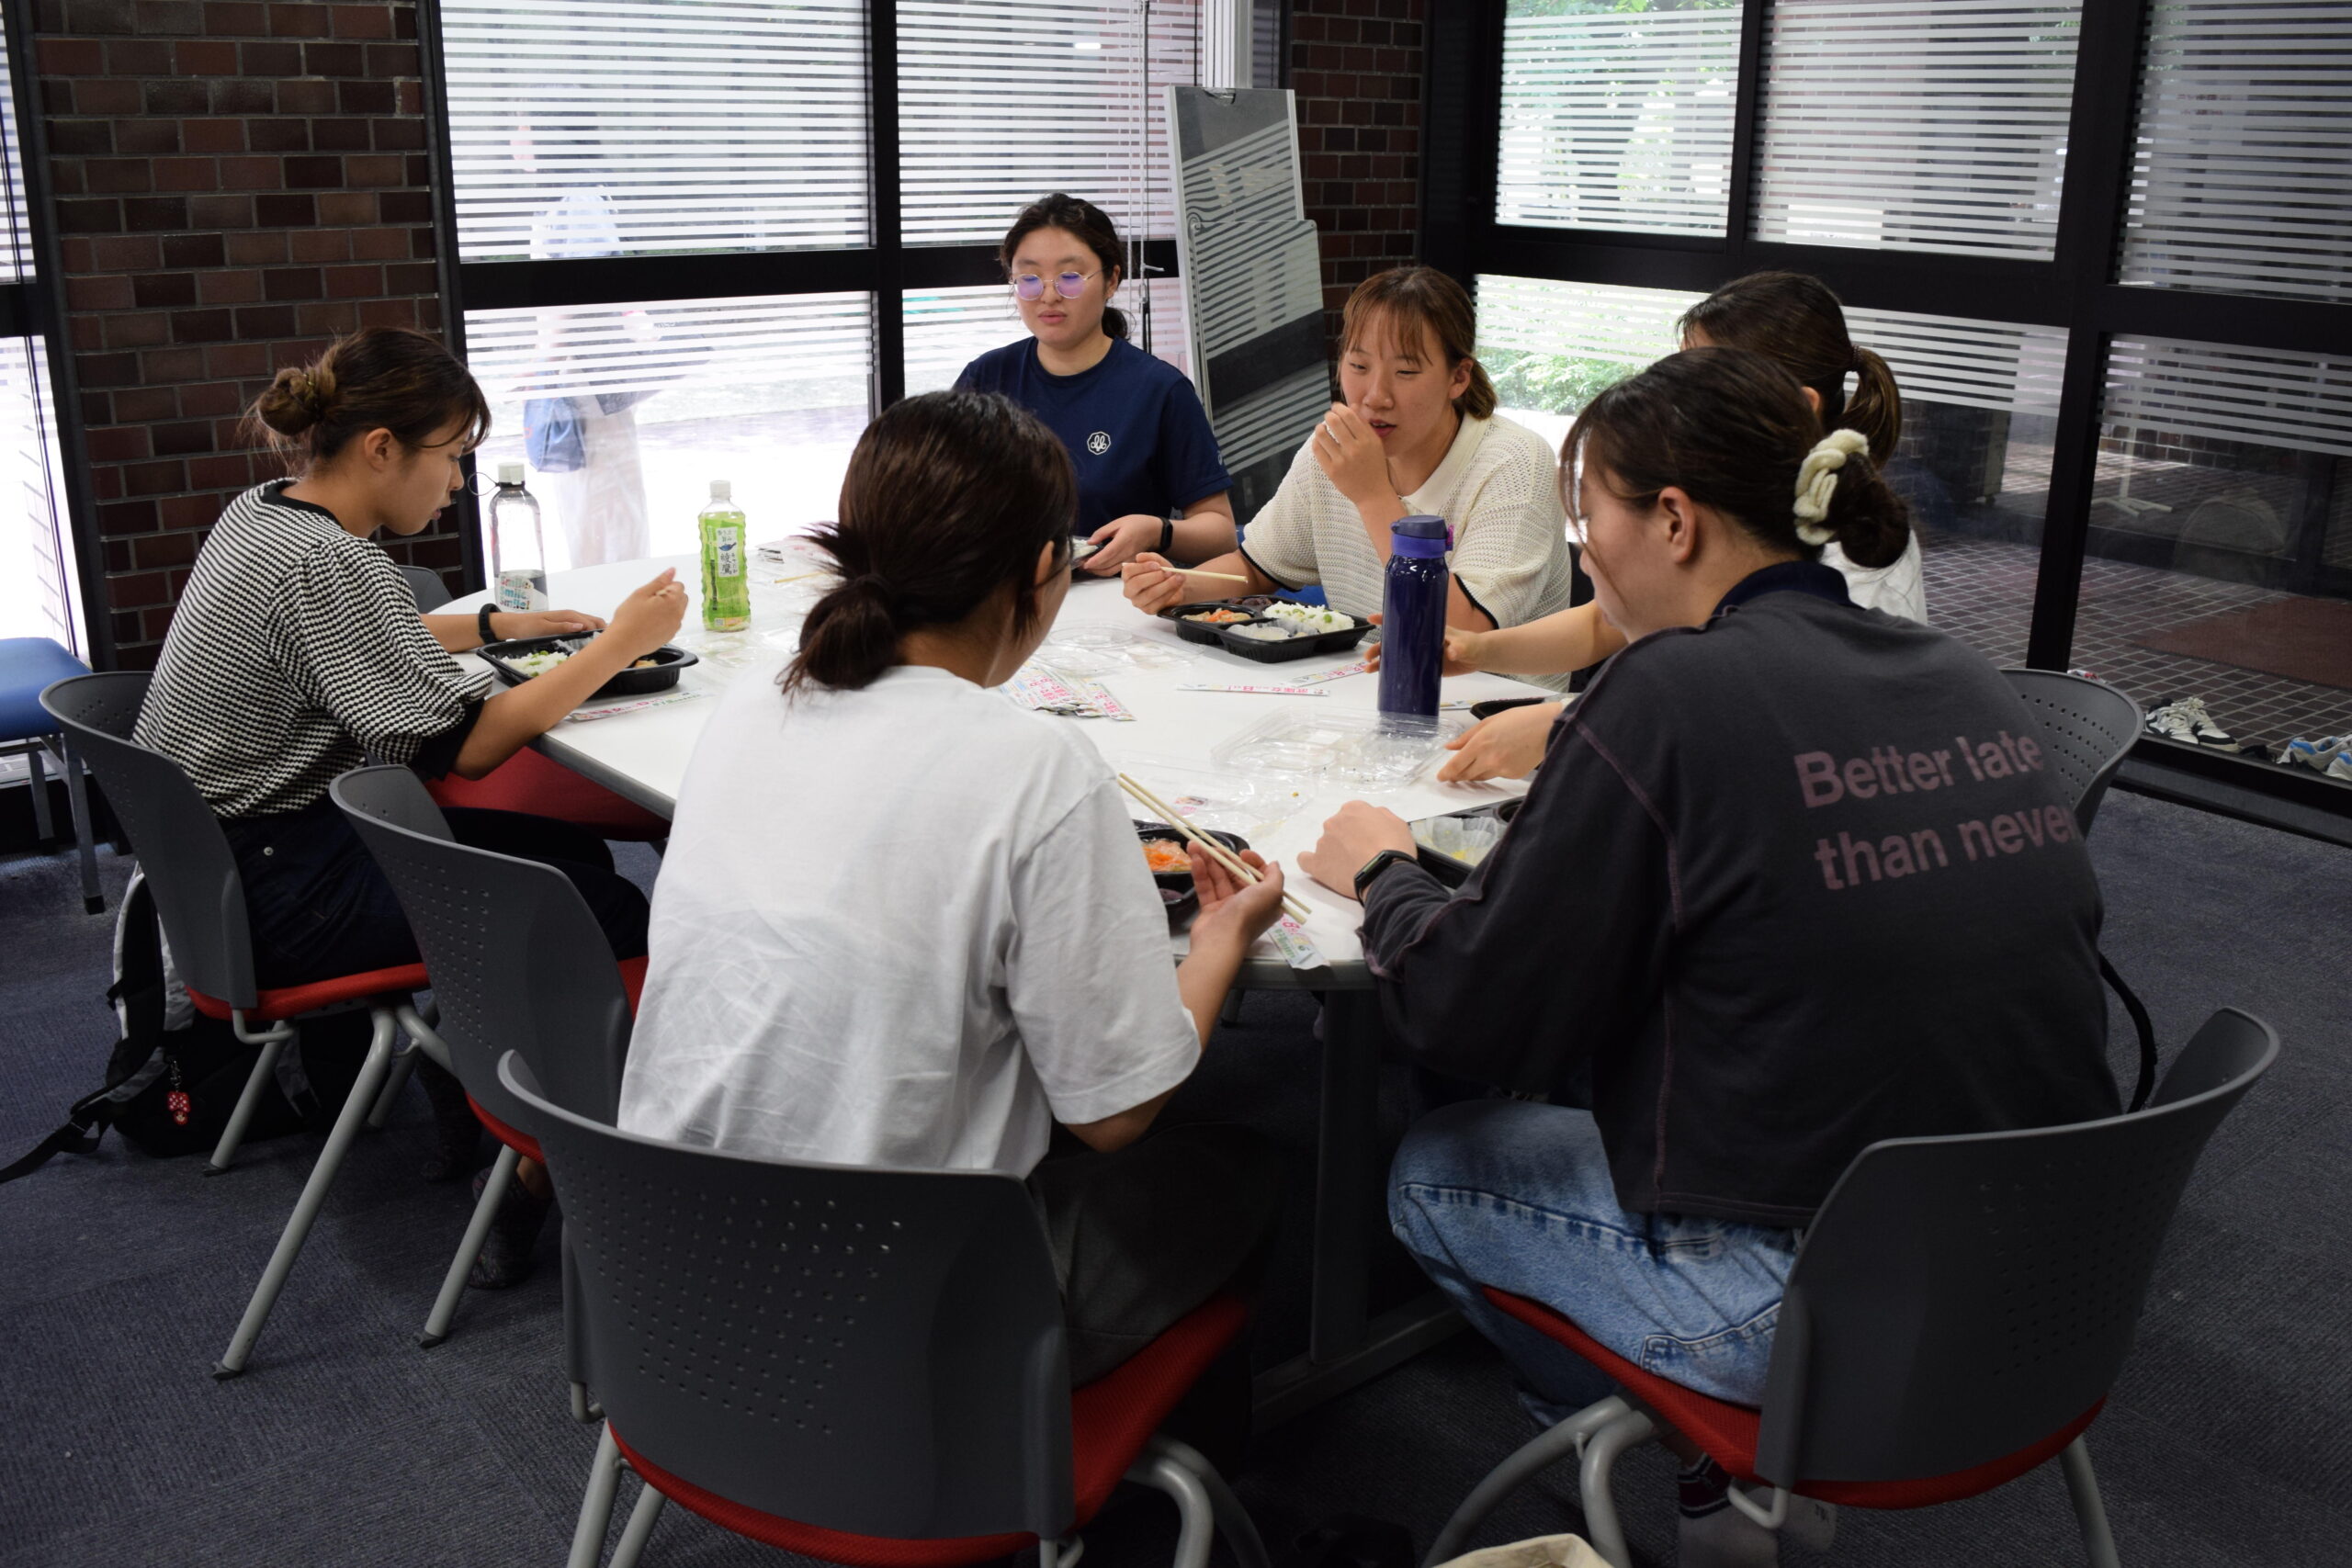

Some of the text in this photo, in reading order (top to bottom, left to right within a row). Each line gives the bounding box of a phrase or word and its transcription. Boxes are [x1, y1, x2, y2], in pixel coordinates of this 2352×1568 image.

[1793, 730, 2044, 809] Better late
[1814, 829, 1949, 890] than
